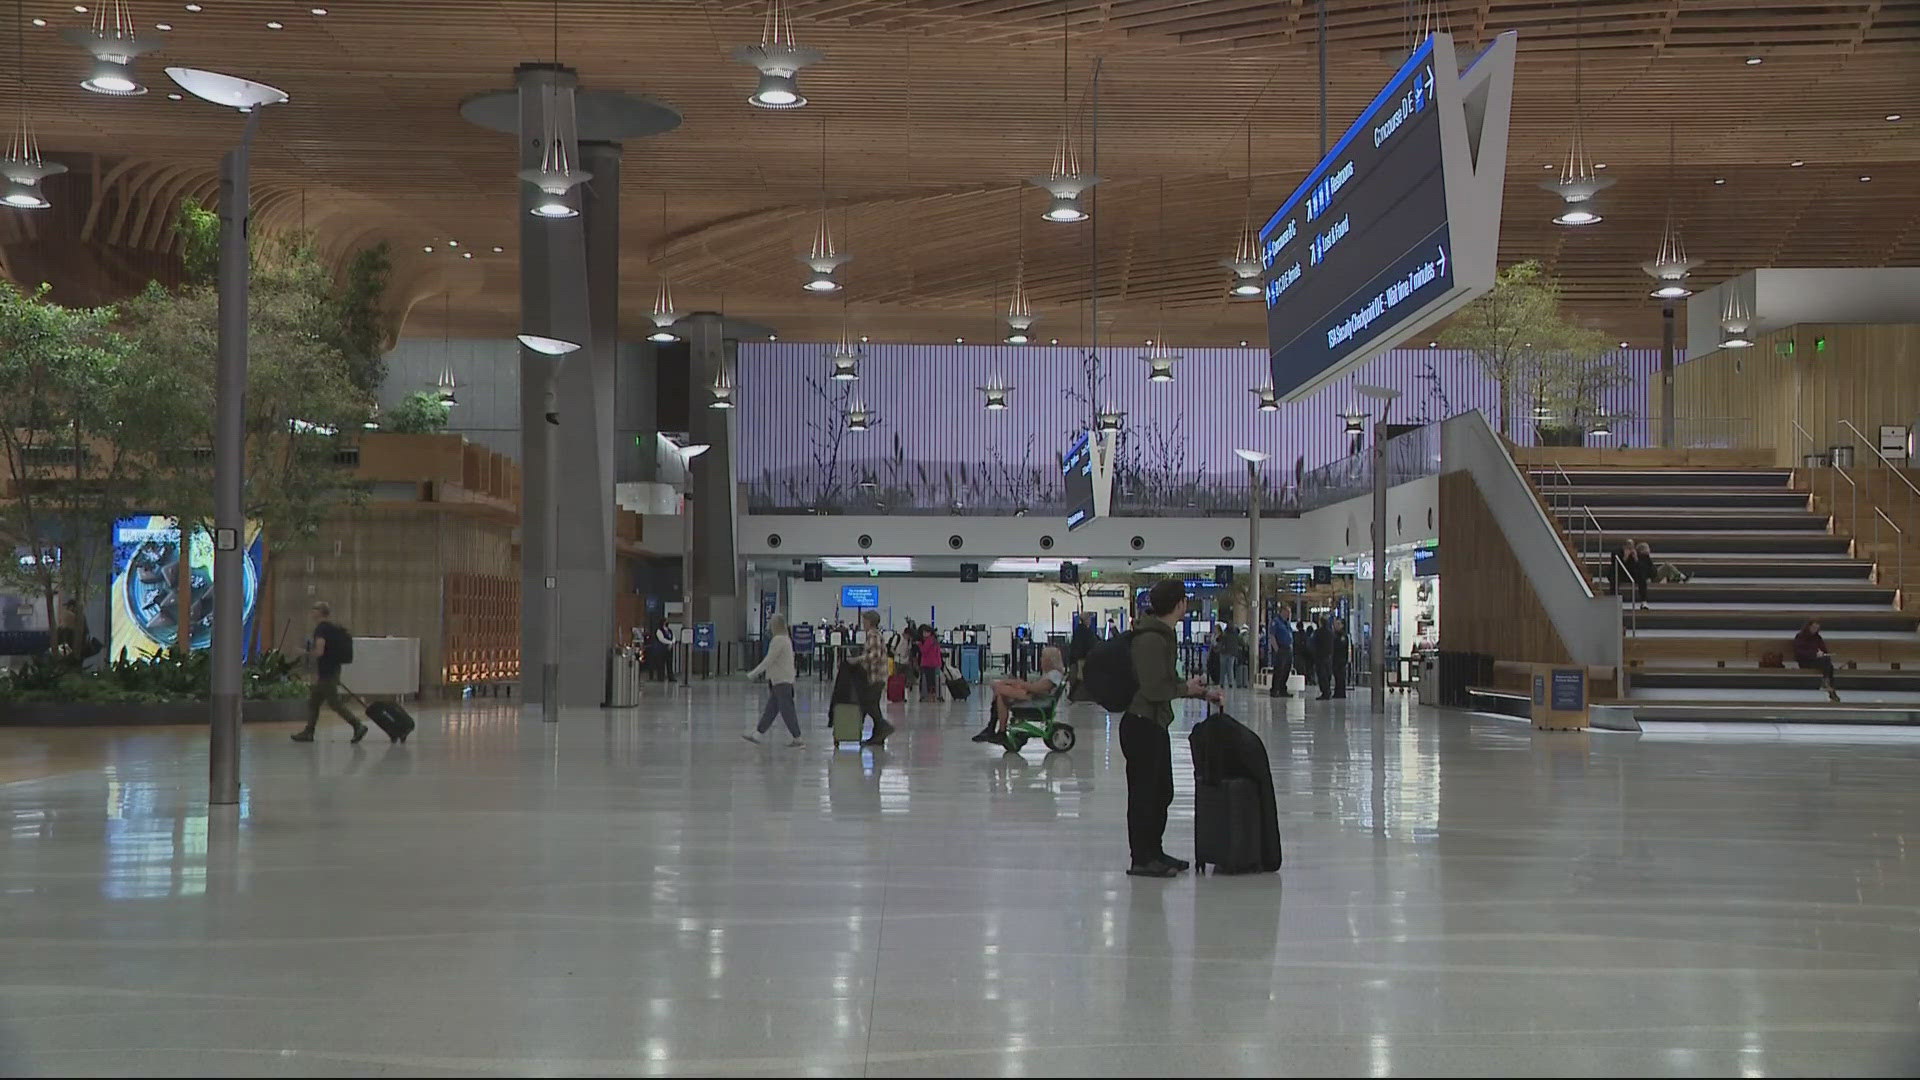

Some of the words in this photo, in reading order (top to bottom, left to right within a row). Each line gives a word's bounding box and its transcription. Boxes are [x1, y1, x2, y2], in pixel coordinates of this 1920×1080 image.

[1374, 108, 1402, 148] Concourse
[1402, 97, 1408, 120] D
[1408, 90, 1414, 113] E
[1330, 161, 1354, 195] Restrooms
[1322, 230, 1332, 252] Lost
[1334, 213, 1350, 240] Found
[1336, 319, 1352, 344] Security
[1351, 301, 1376, 333] Checkpoint
[1374, 296, 1380, 317] D
[1385, 284, 1399, 309] Wait
[1397, 279, 1410, 302] time
[1413, 261, 1435, 291] minutes
